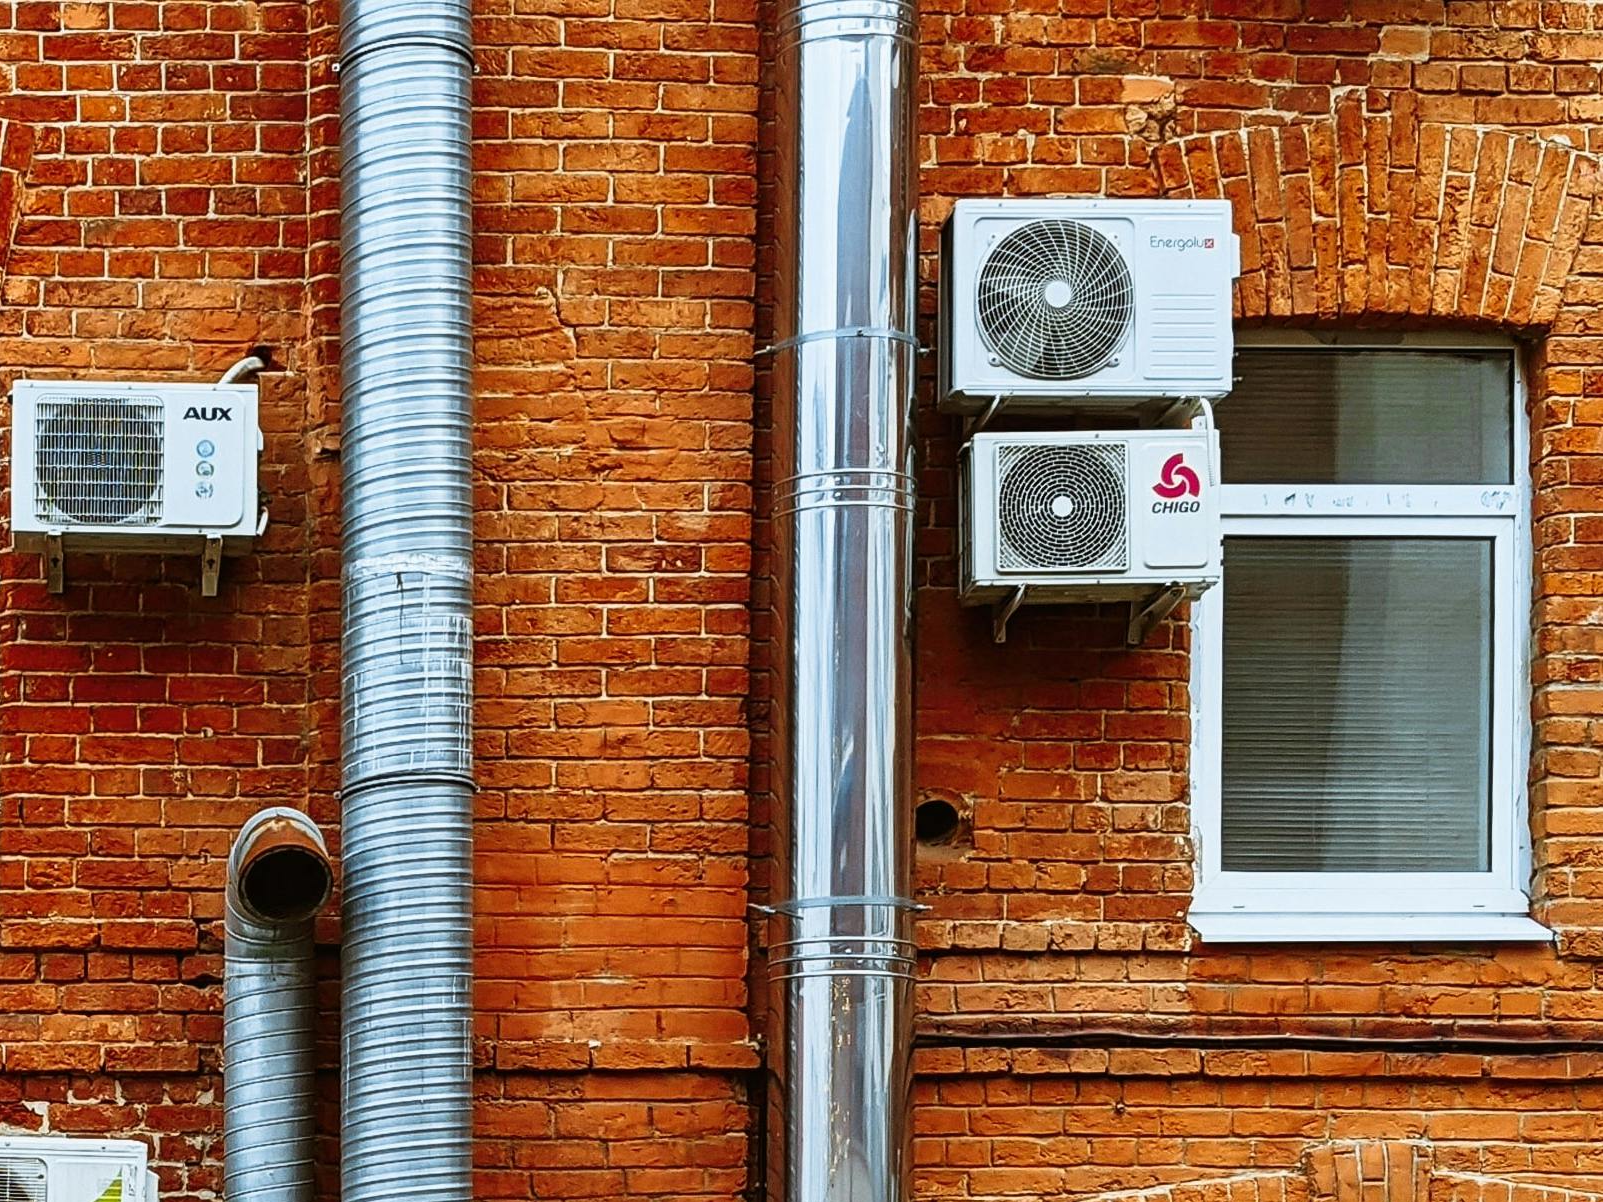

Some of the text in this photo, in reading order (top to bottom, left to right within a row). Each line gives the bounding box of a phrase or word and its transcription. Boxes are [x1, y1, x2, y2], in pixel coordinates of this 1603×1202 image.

[1149, 234, 1214, 252] Energolux
[182, 406, 233, 422] AUX
[1151, 500, 1201, 514] CHIGO
